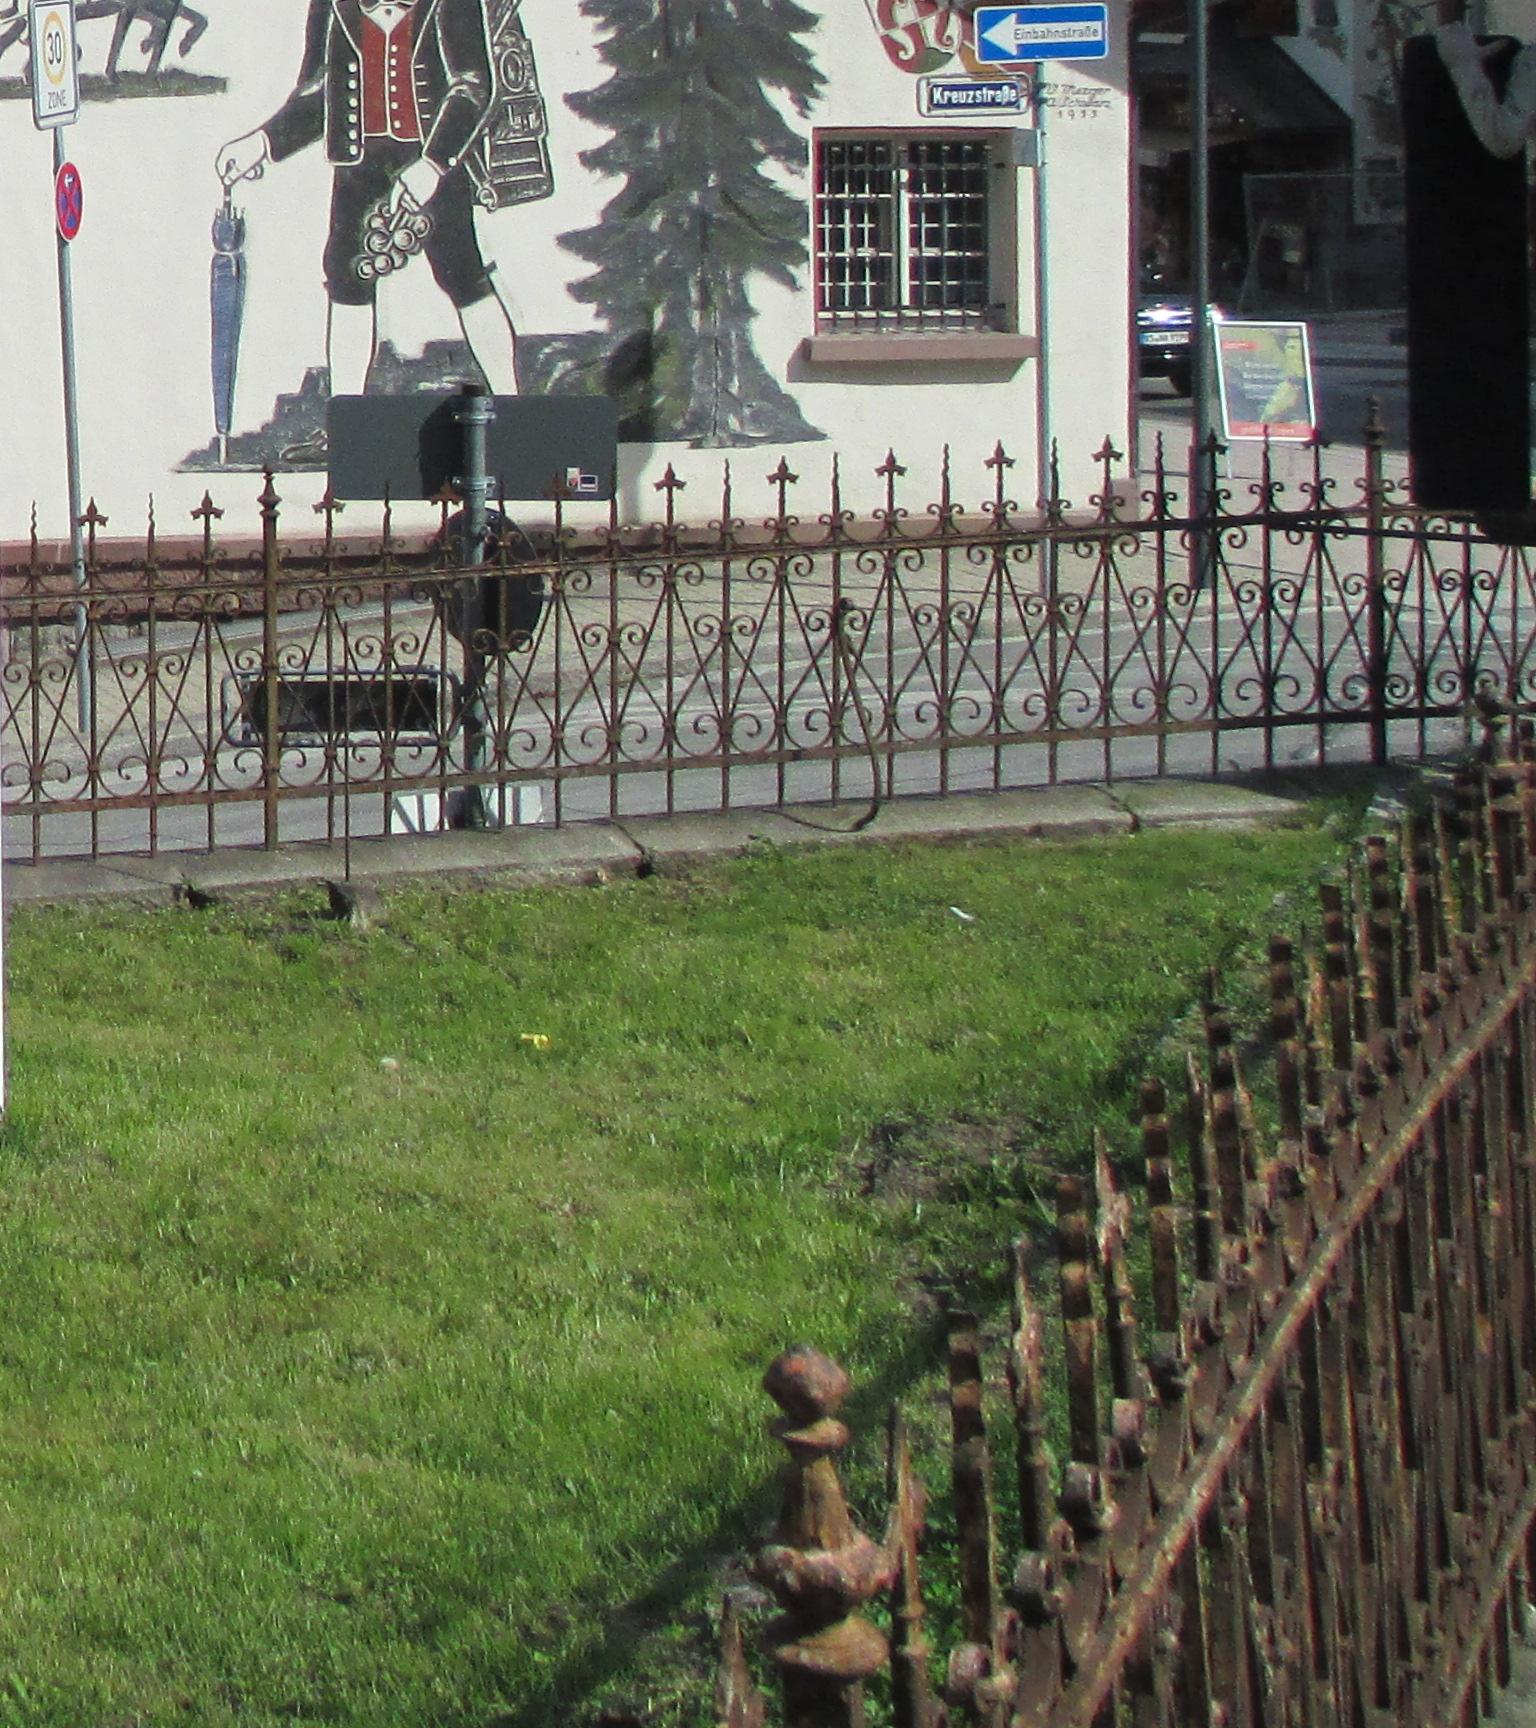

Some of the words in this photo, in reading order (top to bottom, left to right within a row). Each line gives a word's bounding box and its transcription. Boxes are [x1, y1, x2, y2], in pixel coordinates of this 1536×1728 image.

[1013, 25, 1099, 41] Einbahnstraße
[46, 31, 62, 65] 30
[47, 89, 67, 110] ZONE
[932, 85, 1017, 106] Kreuzstraße
